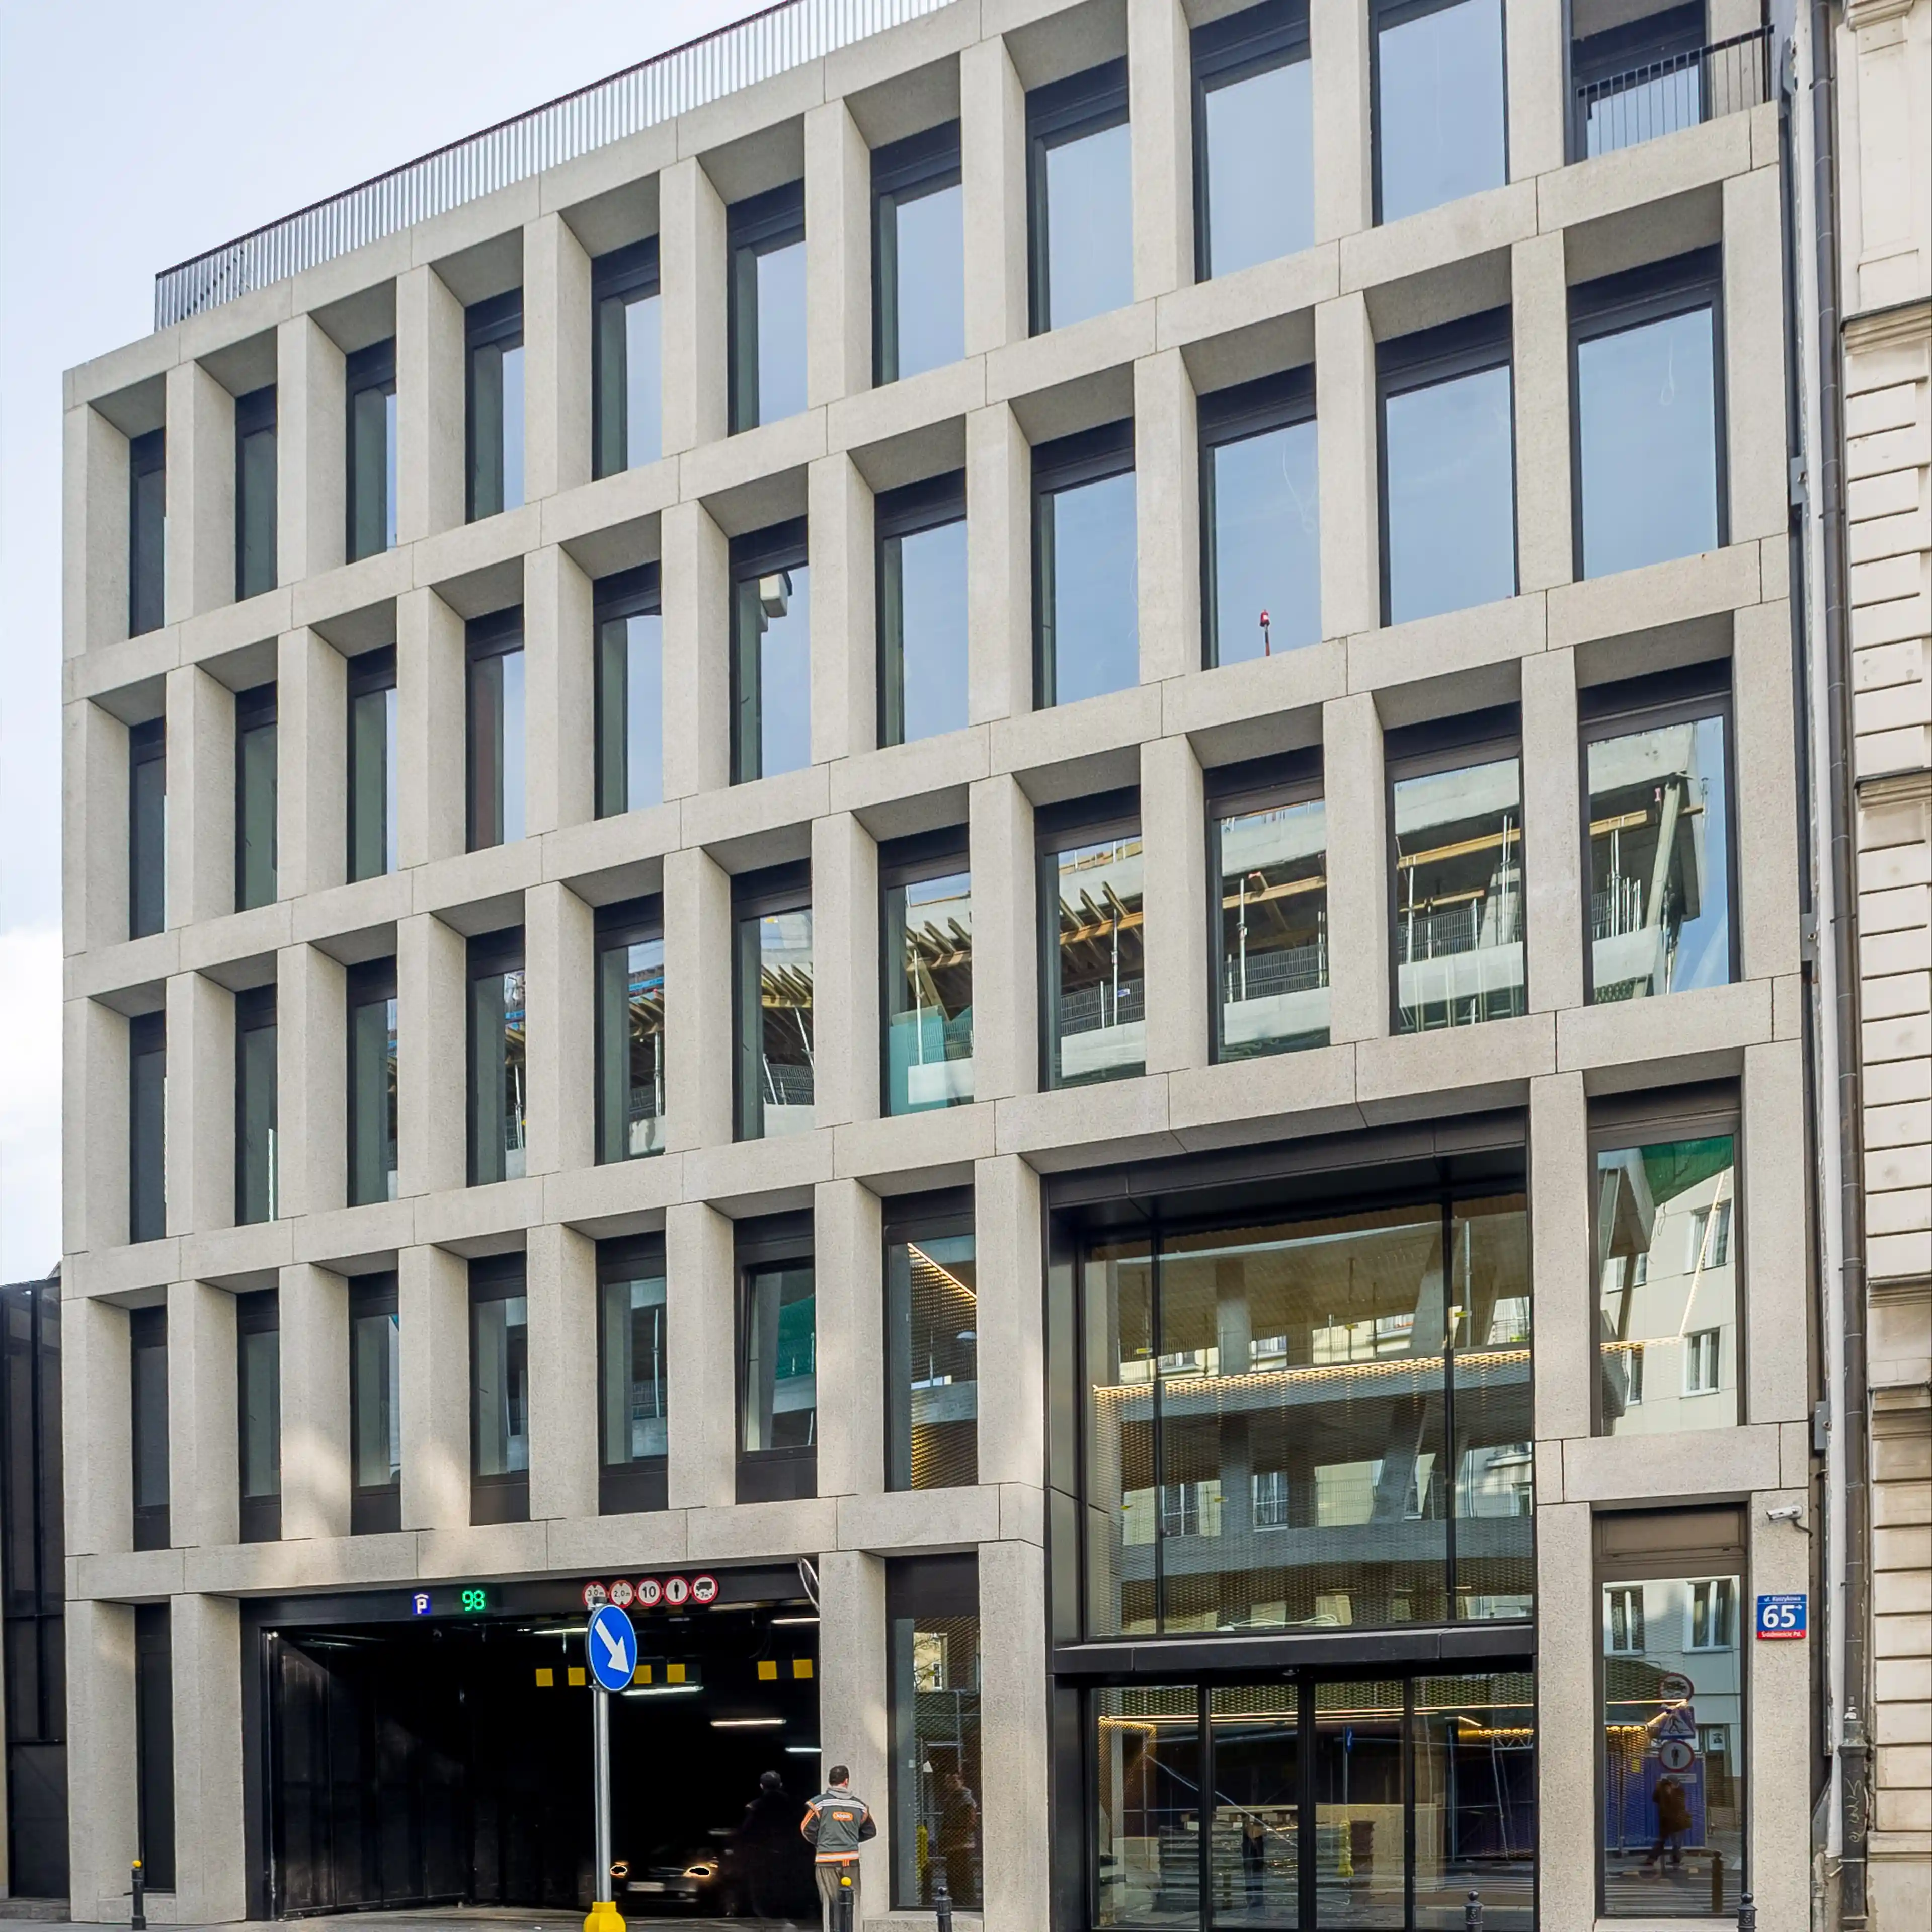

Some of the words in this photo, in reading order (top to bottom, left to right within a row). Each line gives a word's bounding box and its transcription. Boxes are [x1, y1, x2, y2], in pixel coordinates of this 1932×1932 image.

[462, 1590, 485, 1611] 98
[642, 1586, 656, 1598] 10
[1763, 1605, 1795, 1628] 65
